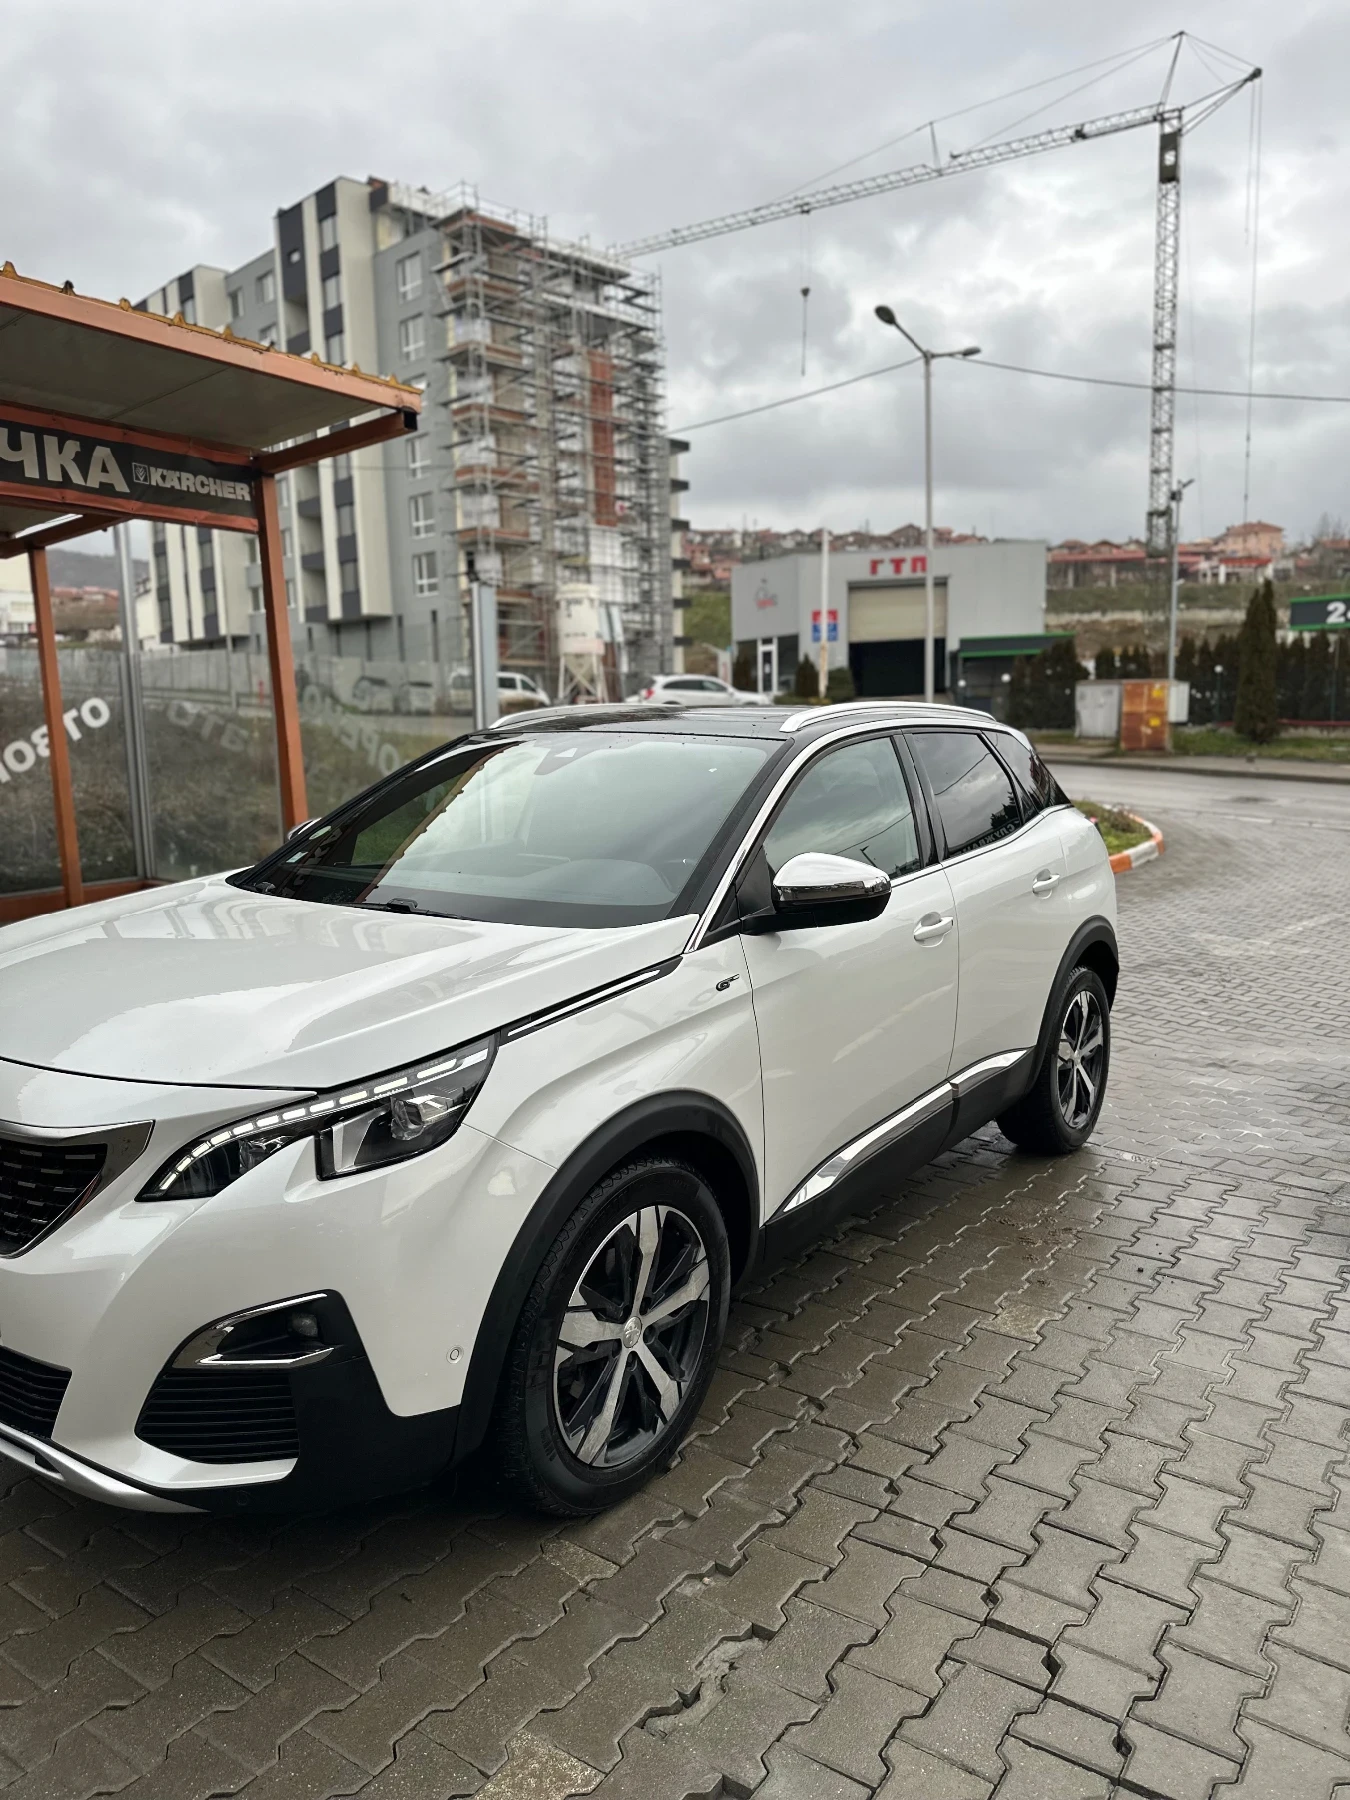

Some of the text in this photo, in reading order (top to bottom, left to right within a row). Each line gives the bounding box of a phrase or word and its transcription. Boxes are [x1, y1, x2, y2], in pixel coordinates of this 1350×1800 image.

[150, 466, 251, 501] KÄRCHER
[870, 557, 927, 575] ГТП
[1325, 601, 1350, 624] 2
